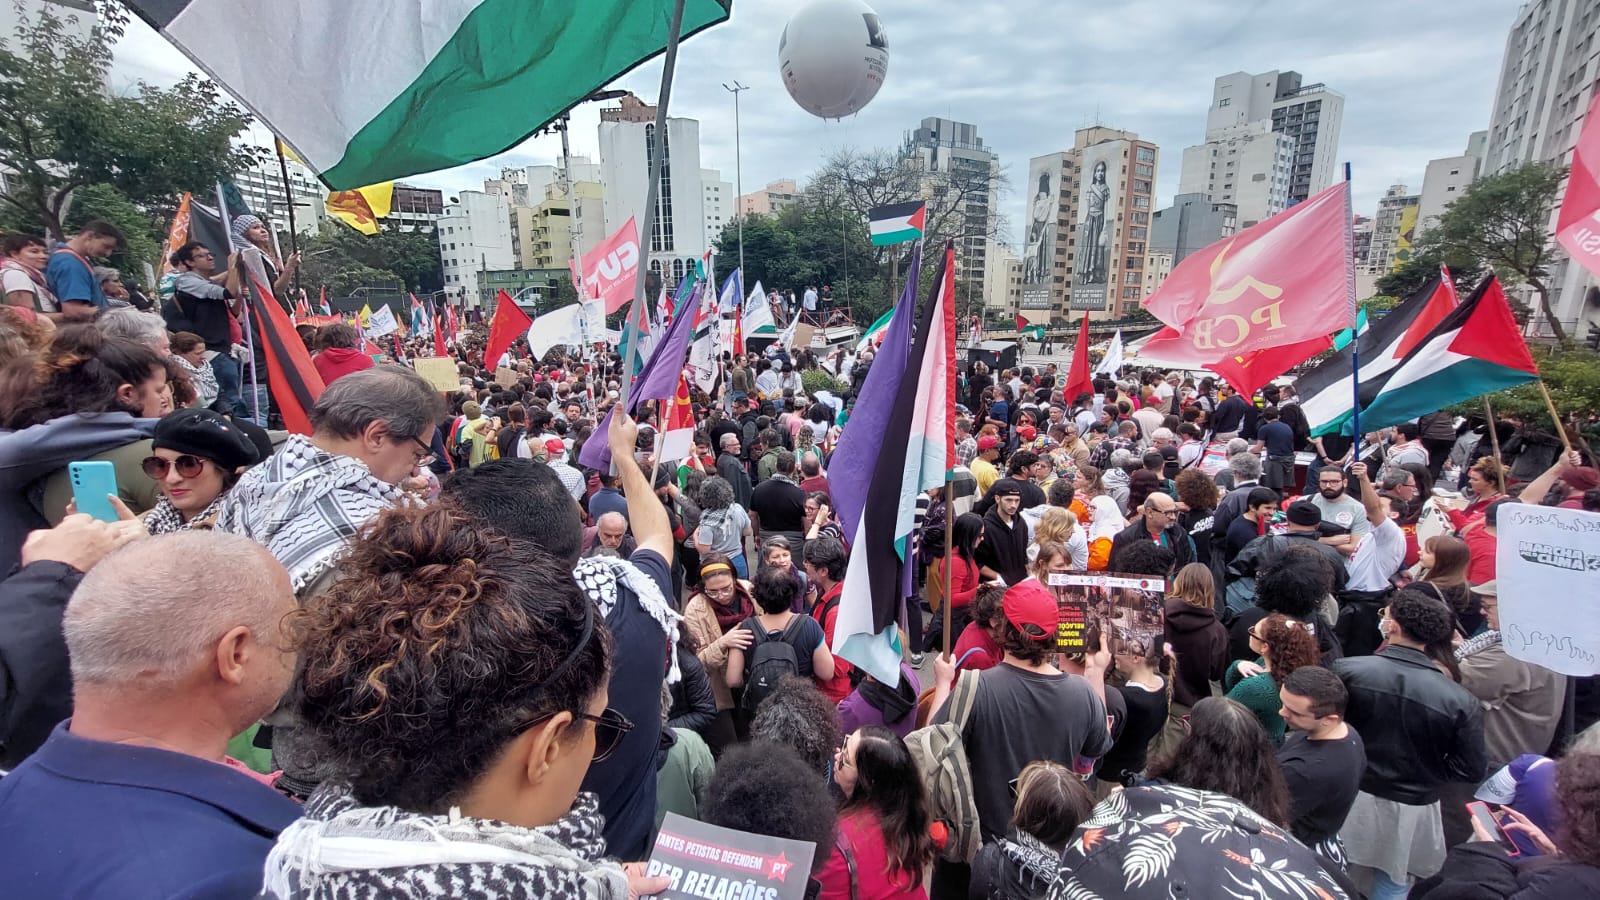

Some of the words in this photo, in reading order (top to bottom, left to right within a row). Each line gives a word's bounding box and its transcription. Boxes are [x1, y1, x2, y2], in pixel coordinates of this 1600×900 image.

[1519, 541, 1584, 560] MARCHA
[1537, 554, 1584, 570] CLIMA
[1057, 639, 1083, 647] BRASIL
[685, 841, 721, 861] PETISTAS
[721, 851, 764, 870] DEFENDEM
[772, 862, 788, 875] PT
